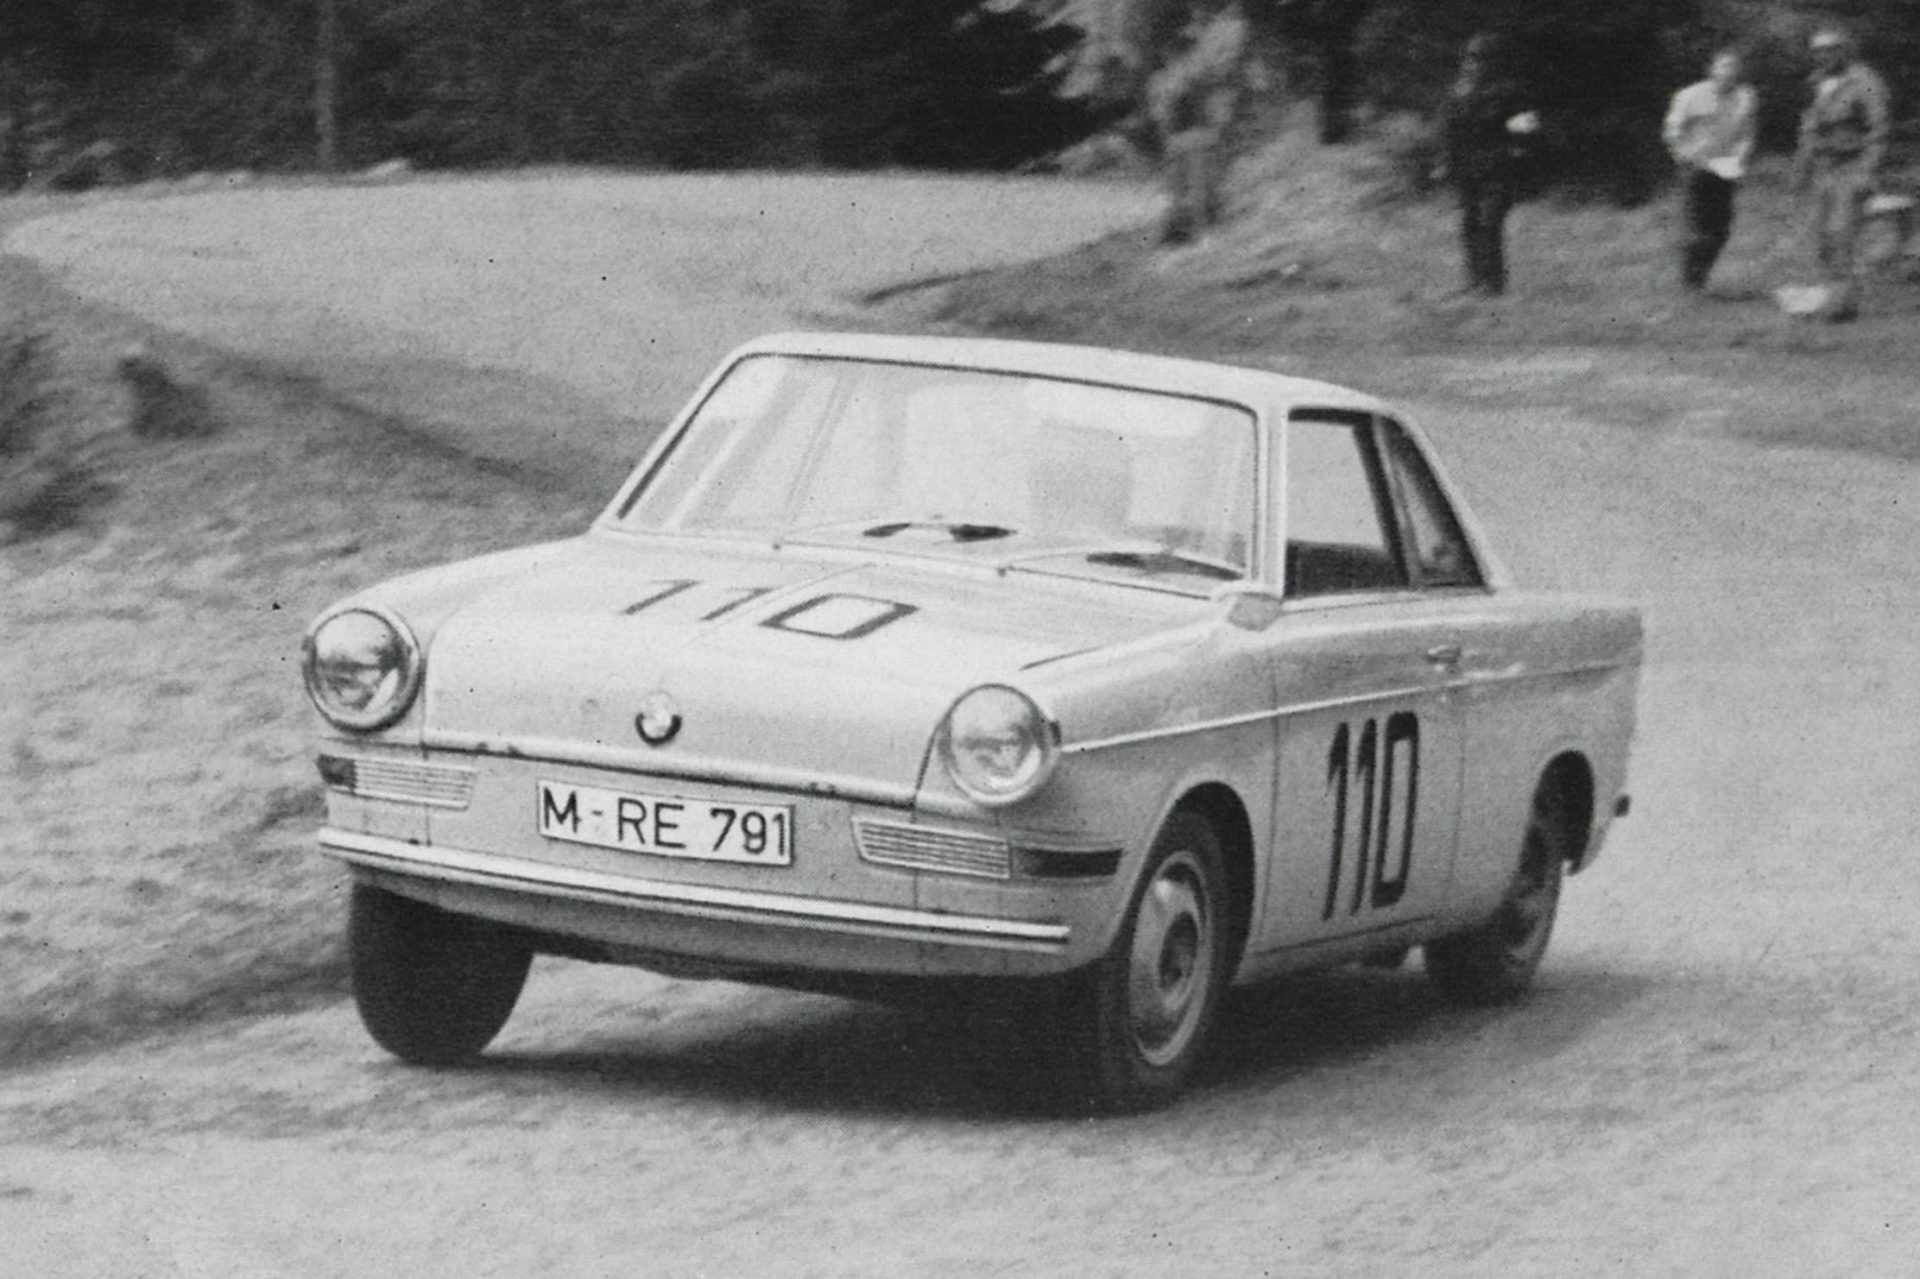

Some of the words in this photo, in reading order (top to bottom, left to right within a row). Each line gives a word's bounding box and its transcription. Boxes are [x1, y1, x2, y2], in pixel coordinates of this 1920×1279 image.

[620, 578, 919, 640] 110
[710, 807, 786, 856] 791
[1322, 711, 1419, 921] 110
